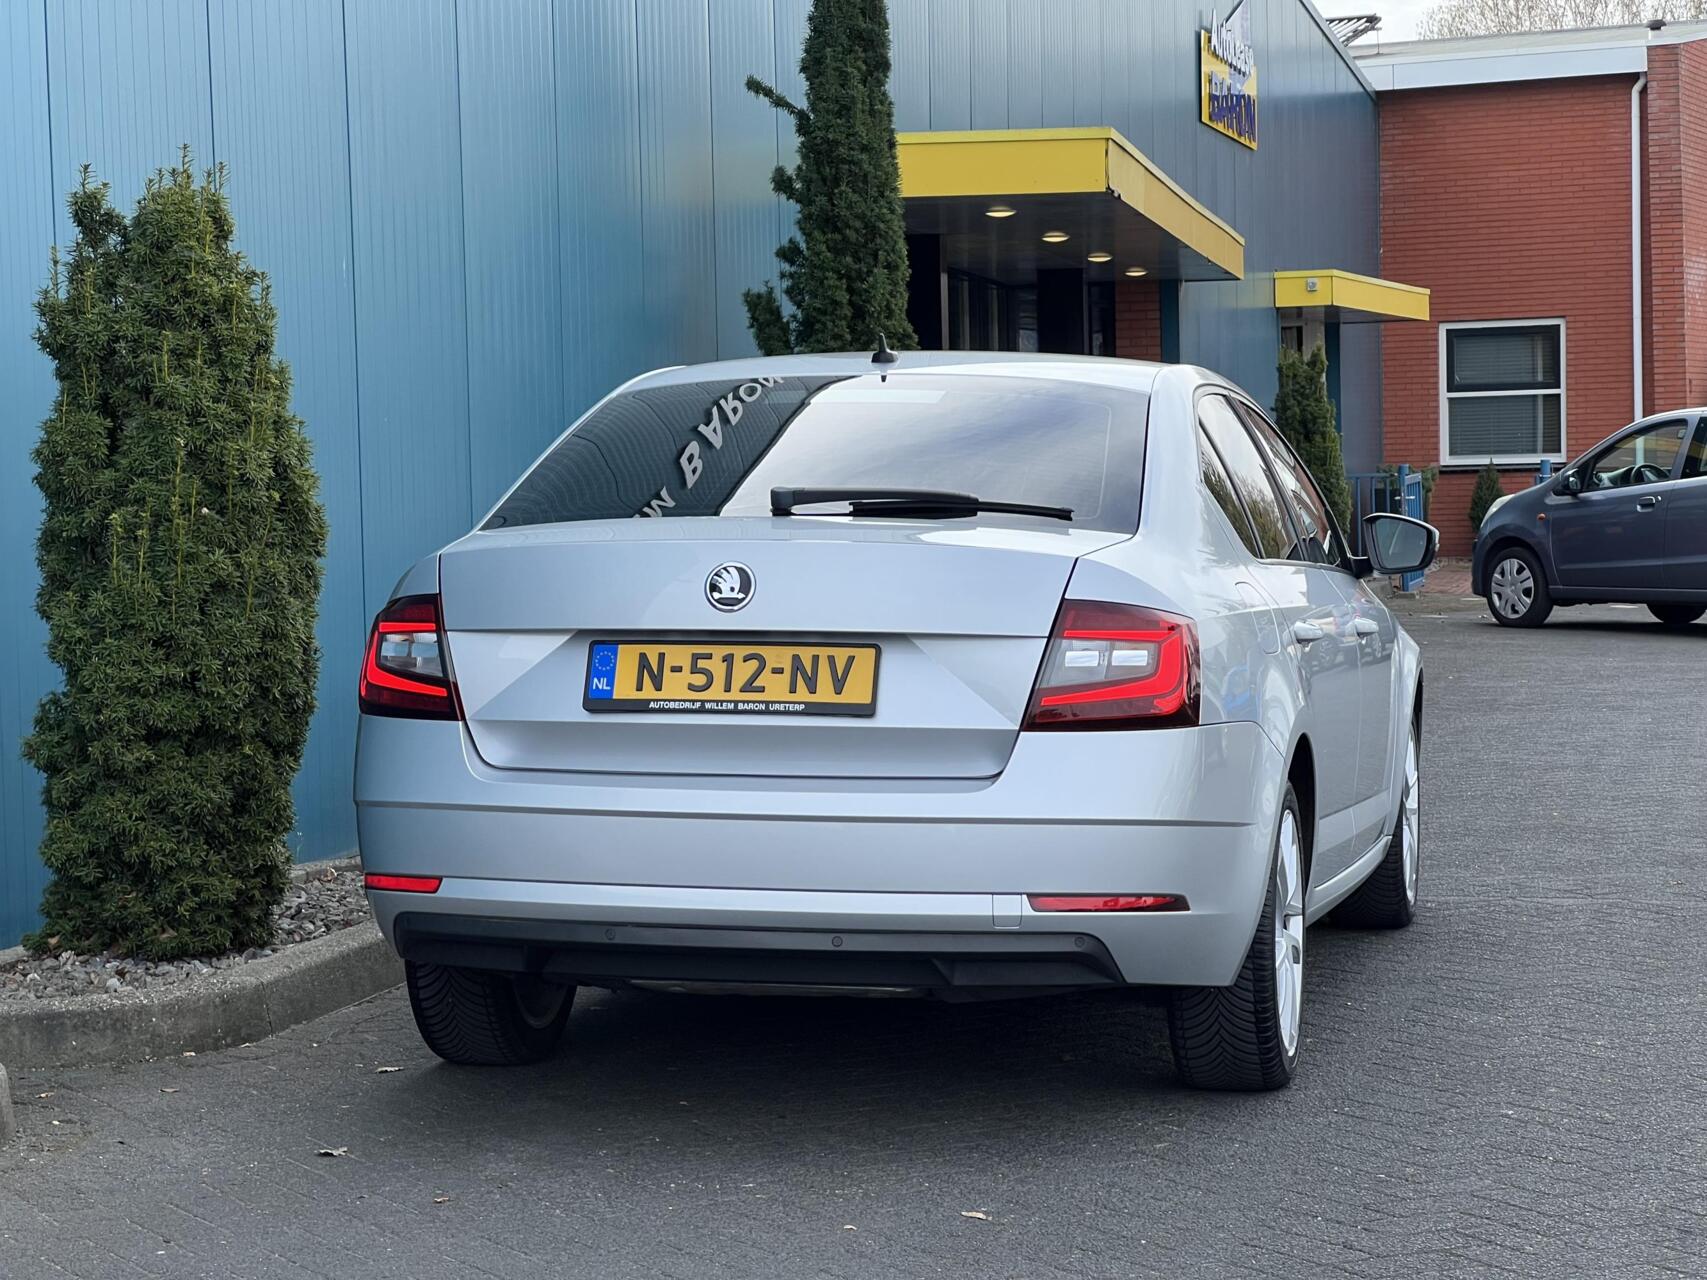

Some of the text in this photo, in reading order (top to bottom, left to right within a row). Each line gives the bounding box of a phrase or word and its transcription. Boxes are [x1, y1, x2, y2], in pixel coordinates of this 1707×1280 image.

[636, 652, 855, 695] N-512-NV
[593, 678, 611, 690] NL
[649, 701, 702, 710] AUTOBEDRIJF
[705, 702, 735, 711] WILLEM
[738, 703, 766, 711] BARON
